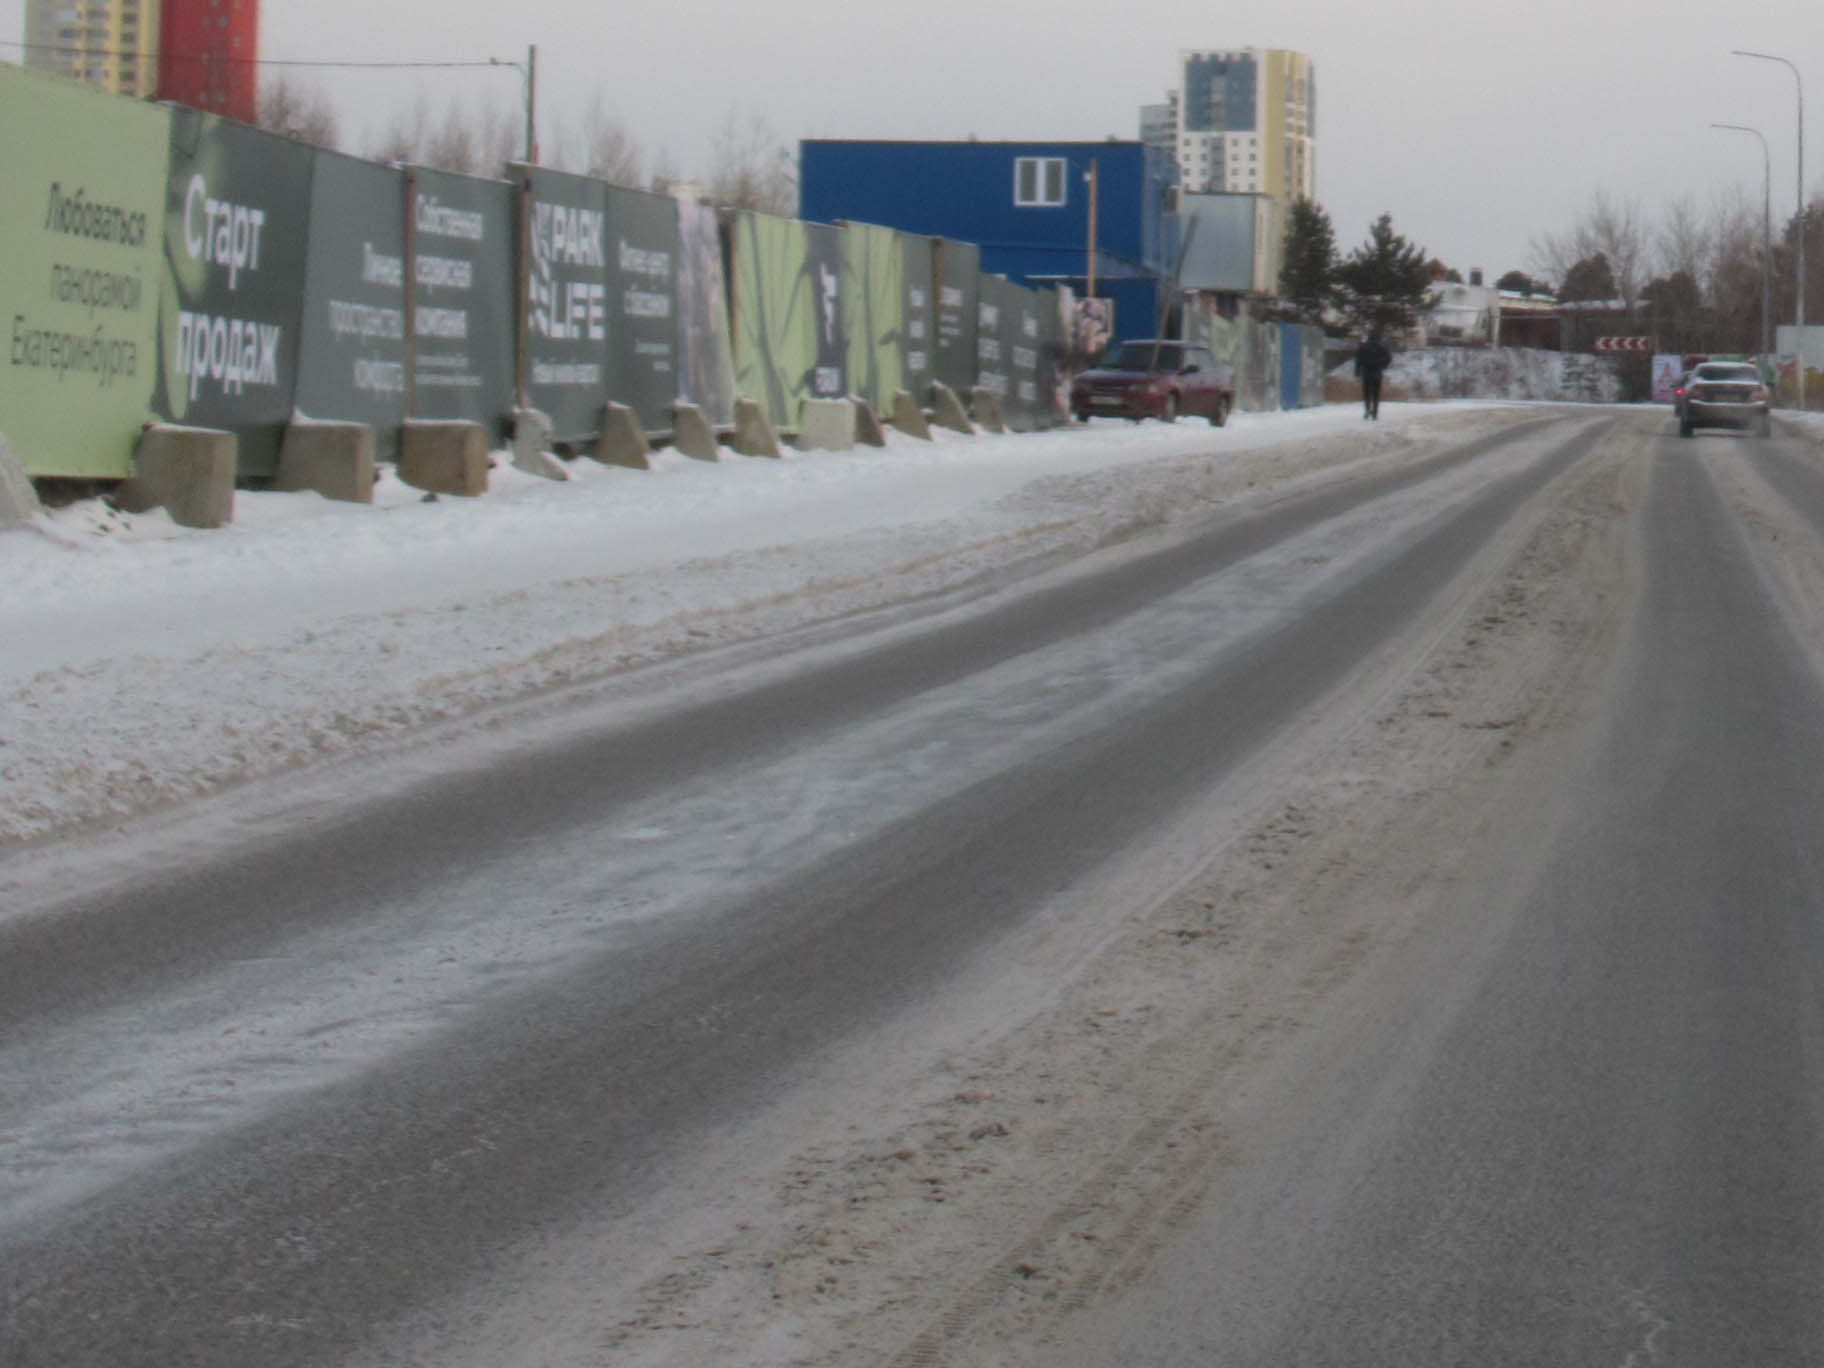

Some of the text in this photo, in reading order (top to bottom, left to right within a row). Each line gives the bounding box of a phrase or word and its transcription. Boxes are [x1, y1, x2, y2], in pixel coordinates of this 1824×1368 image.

[45, 181, 146, 248] Любоваться
[184, 173, 265, 291] Старт
[551, 203, 606, 268] PARK
[51, 263, 142, 319] панорамой
[550, 280, 606, 341] LIFE
[10, 313, 137, 388] Екатеринбурга
[175, 310, 280, 402] продаж
